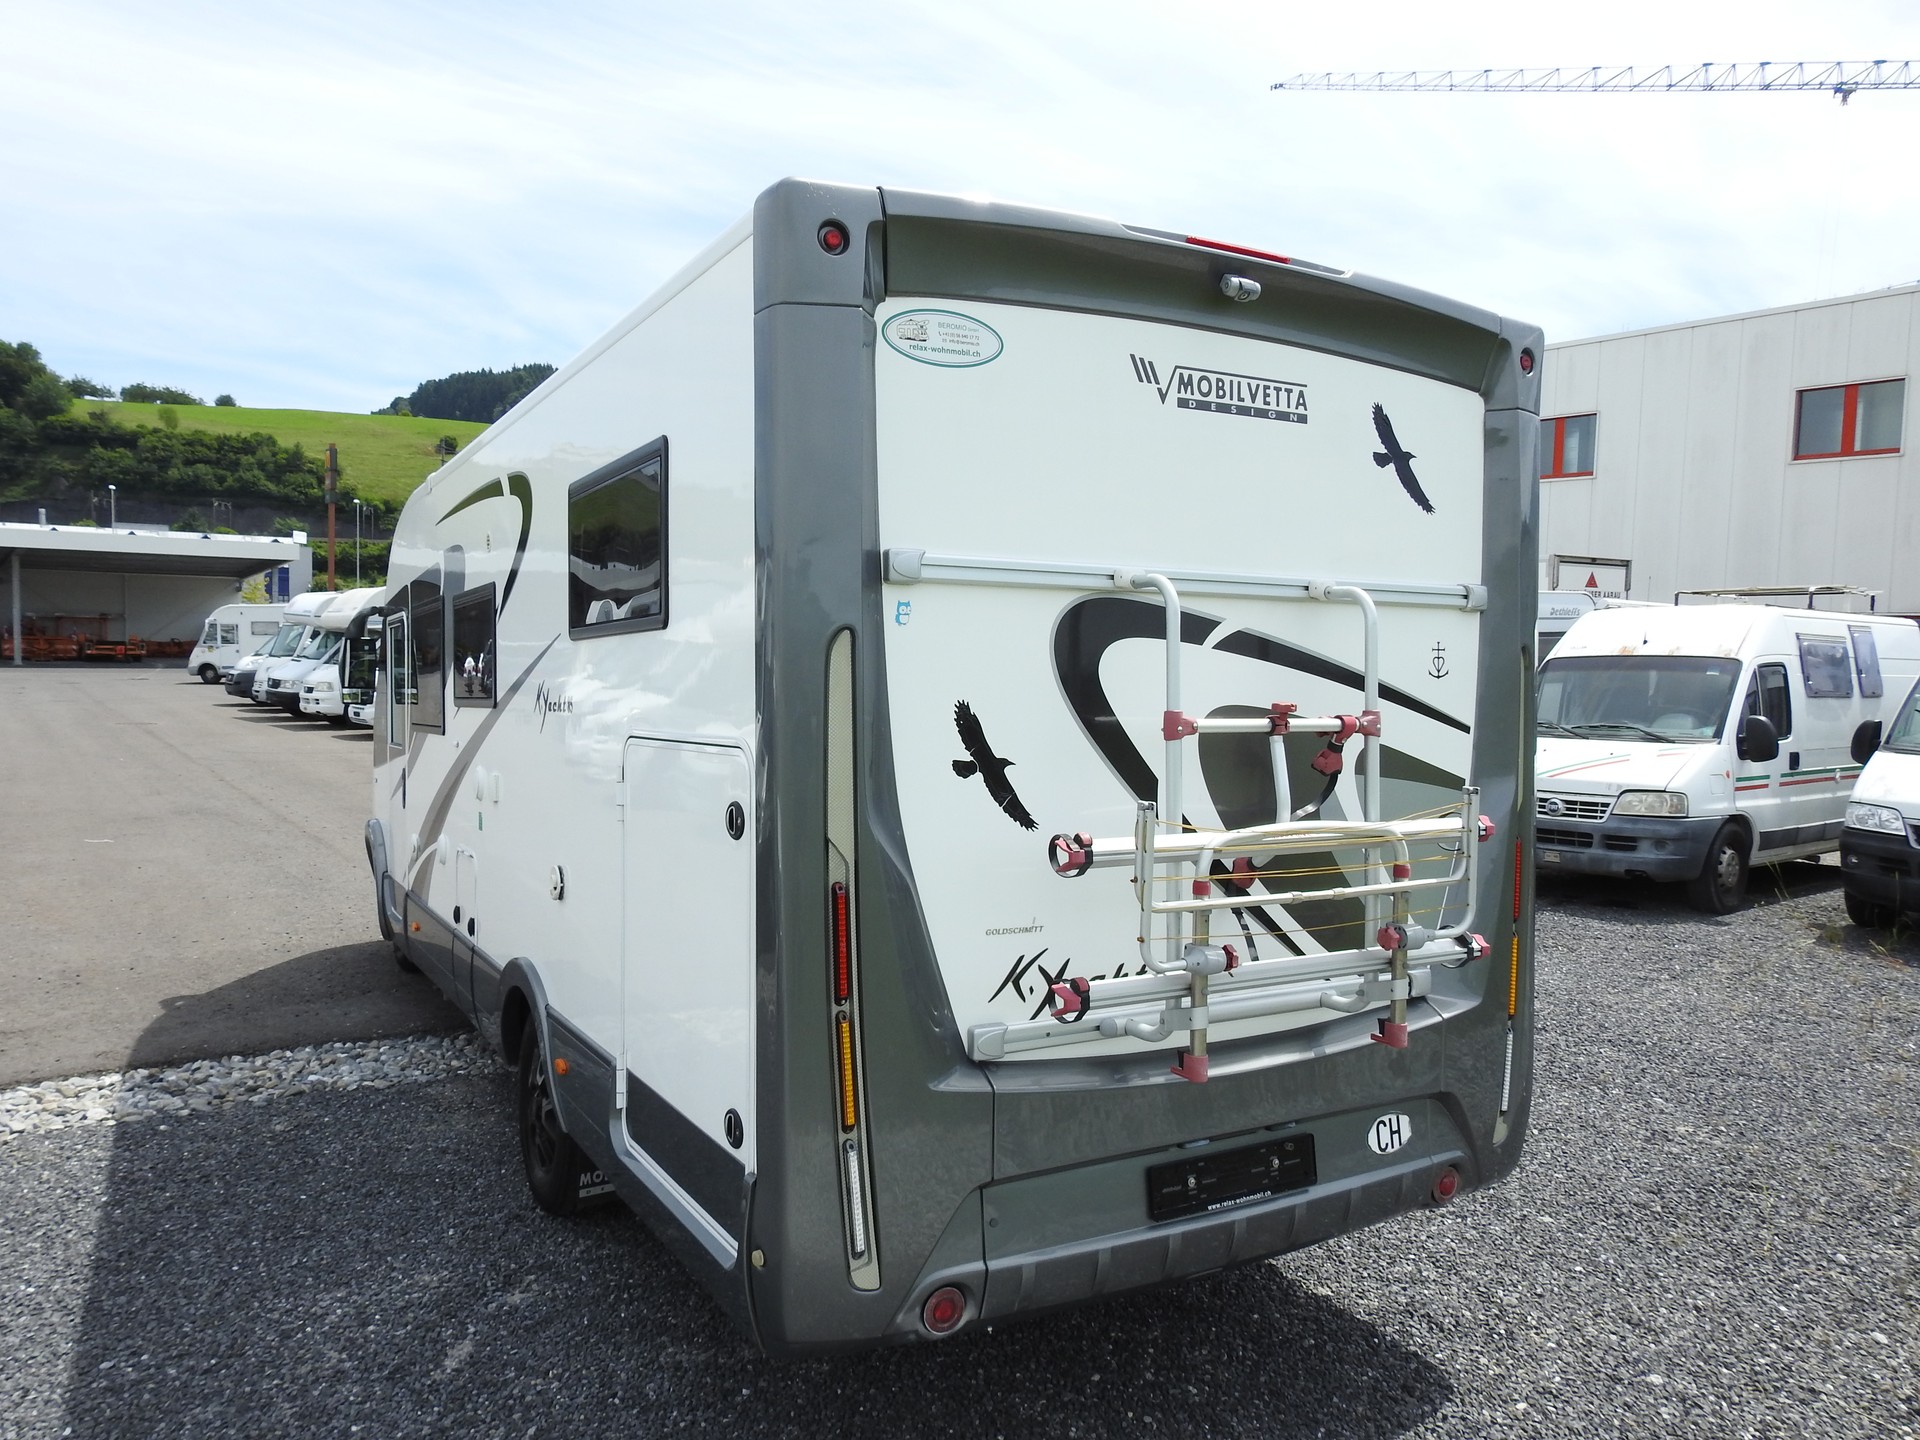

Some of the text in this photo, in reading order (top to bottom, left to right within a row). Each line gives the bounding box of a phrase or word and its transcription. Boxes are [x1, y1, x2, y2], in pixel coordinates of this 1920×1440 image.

[909, 343, 981, 358] relax-wohnmobil.ch
[1177, 372, 1308, 411] MOBILVETTA
[1188, 400, 1298, 422] DESIGN
[1550, 607, 1580, 616] Dethleffs
[1376, 1115, 1403, 1153] CH
[1207, 1190, 1272, 1211] www.relax-wohnmobil.ch
